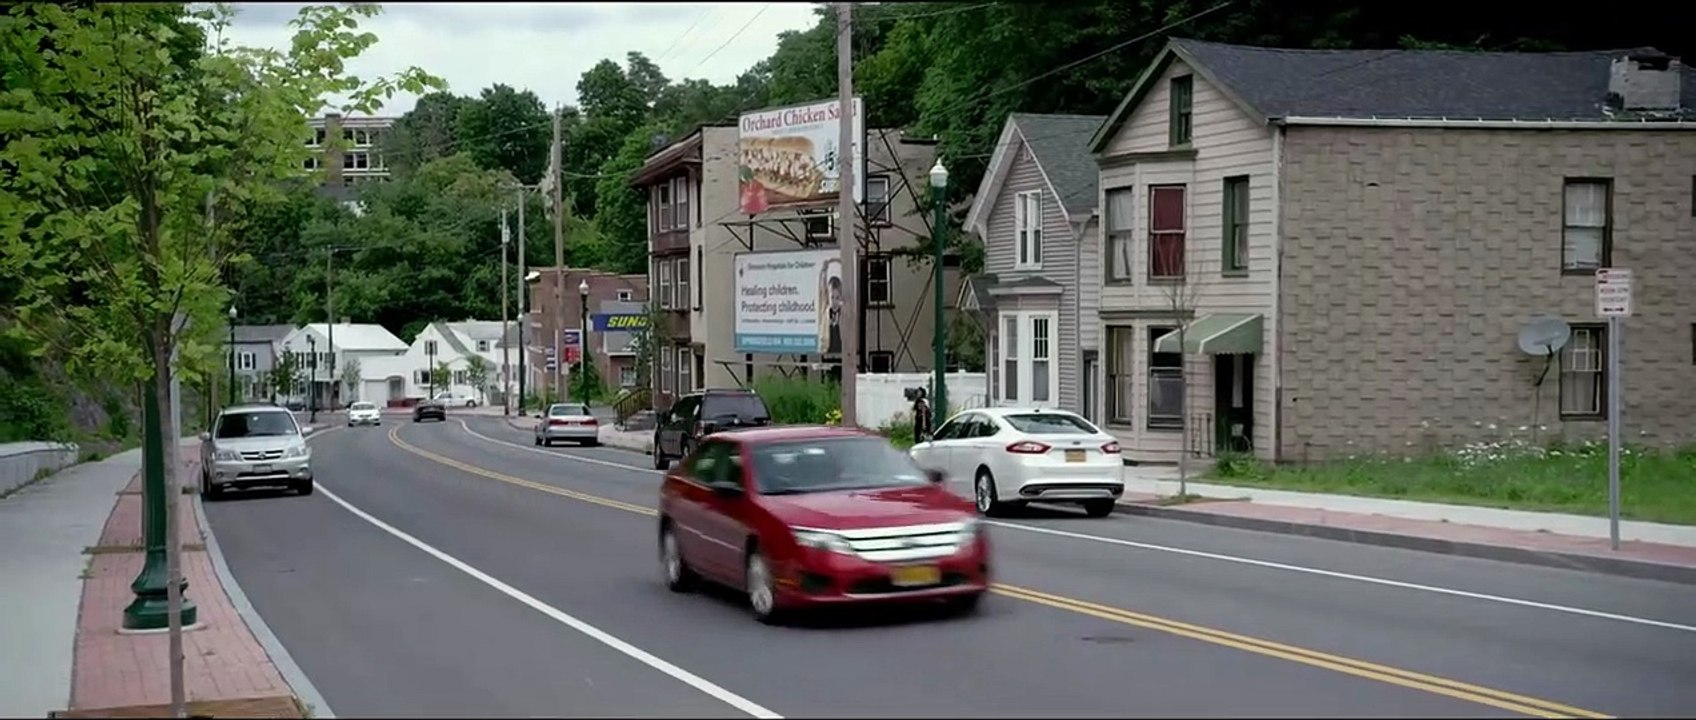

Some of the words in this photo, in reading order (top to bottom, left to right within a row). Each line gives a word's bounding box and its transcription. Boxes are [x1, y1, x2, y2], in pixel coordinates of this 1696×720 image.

[742, 112, 782, 132] Orchard
[783, 107, 826, 127] Chicken
[741, 284, 767, 299] Healing
[769, 283, 799, 296] children.
[741, 301, 777, 315] Protecting
